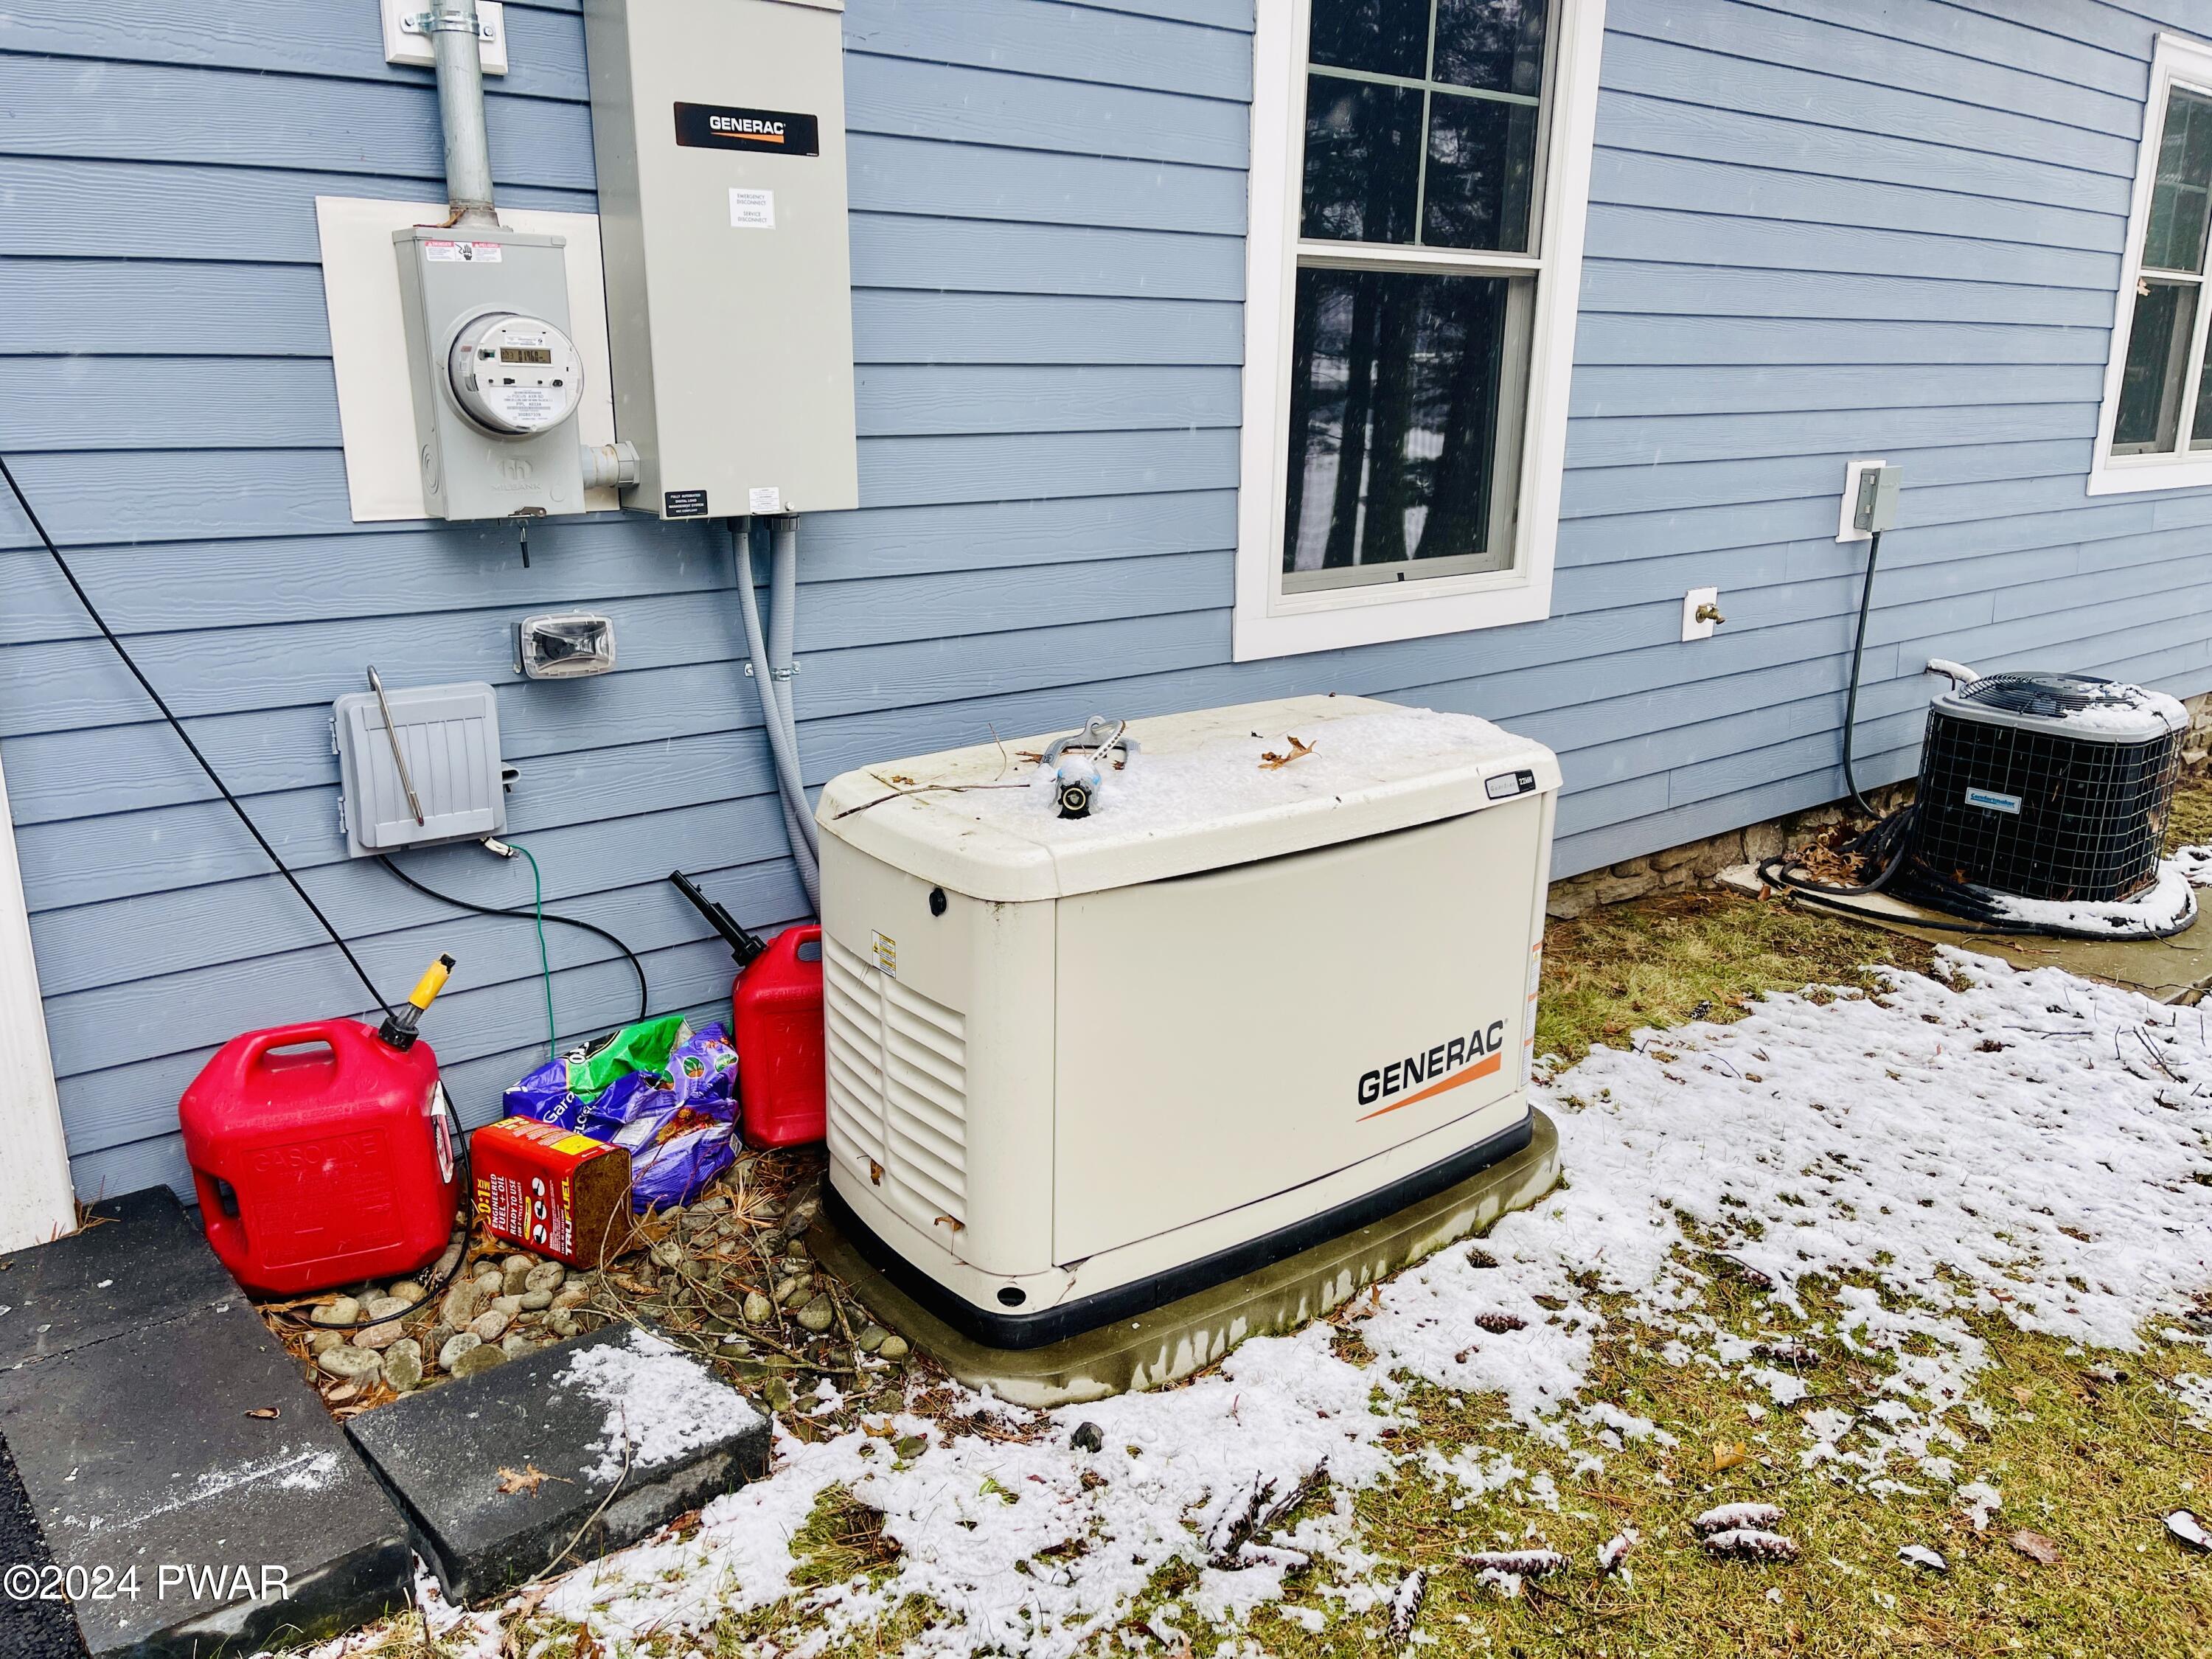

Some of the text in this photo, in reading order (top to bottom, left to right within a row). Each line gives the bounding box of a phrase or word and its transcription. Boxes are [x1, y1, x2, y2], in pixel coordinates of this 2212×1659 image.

[709, 116, 785, 134] GENERAC
[1970, 793, 2015, 807] Comfortmaker
[1358, 1020, 1503, 1105] GENERAC
[254, 1135, 378, 1172] GASOLINE
[478, 1178, 490, 1190] MIX
[490, 1174, 498, 1229] ENGINEERED
[510, 1196, 518, 1206] TO
[498, 1206, 506, 1231] FUEL
[561, 1176, 573, 1256] TRUFUEL
